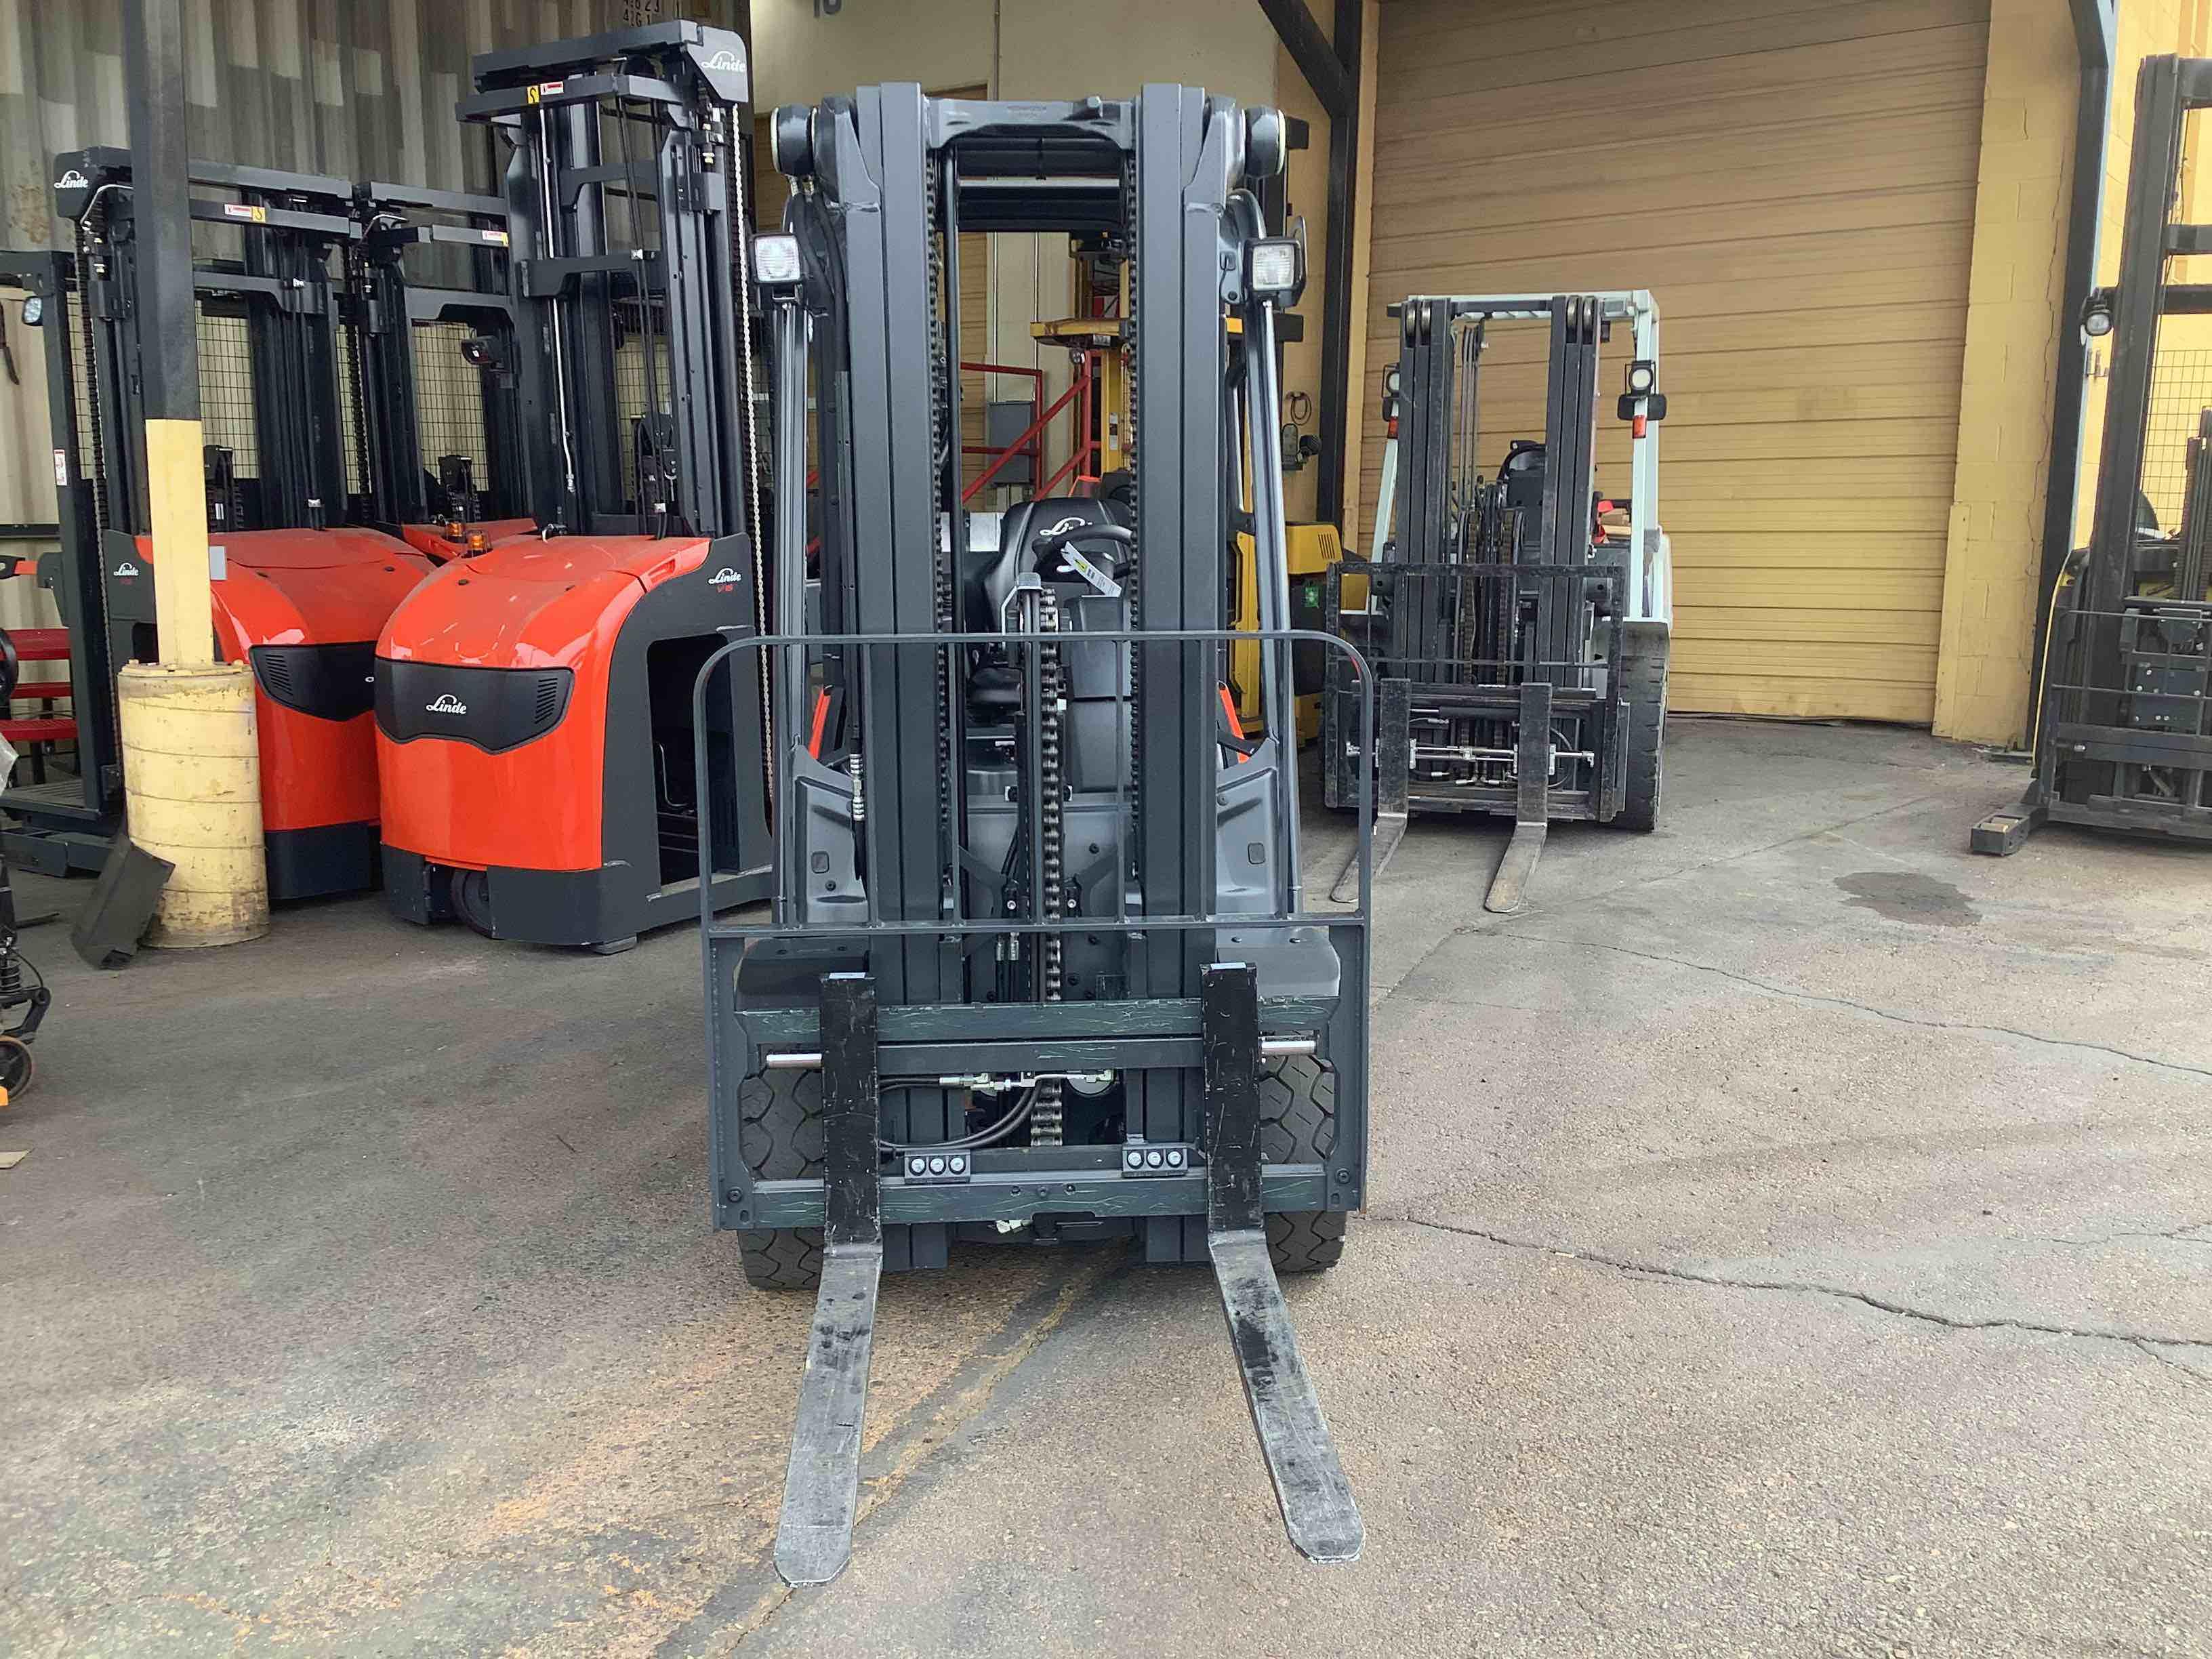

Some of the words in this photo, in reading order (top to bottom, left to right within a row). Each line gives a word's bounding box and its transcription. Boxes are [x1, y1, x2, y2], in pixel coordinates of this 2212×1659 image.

[701, 51, 745, 72] Linde
[54, 170, 89, 188] Linde
[113, 562, 139, 576] Linde
[708, 567, 741, 584] Linde
[426, 694, 467, 714] Linde
